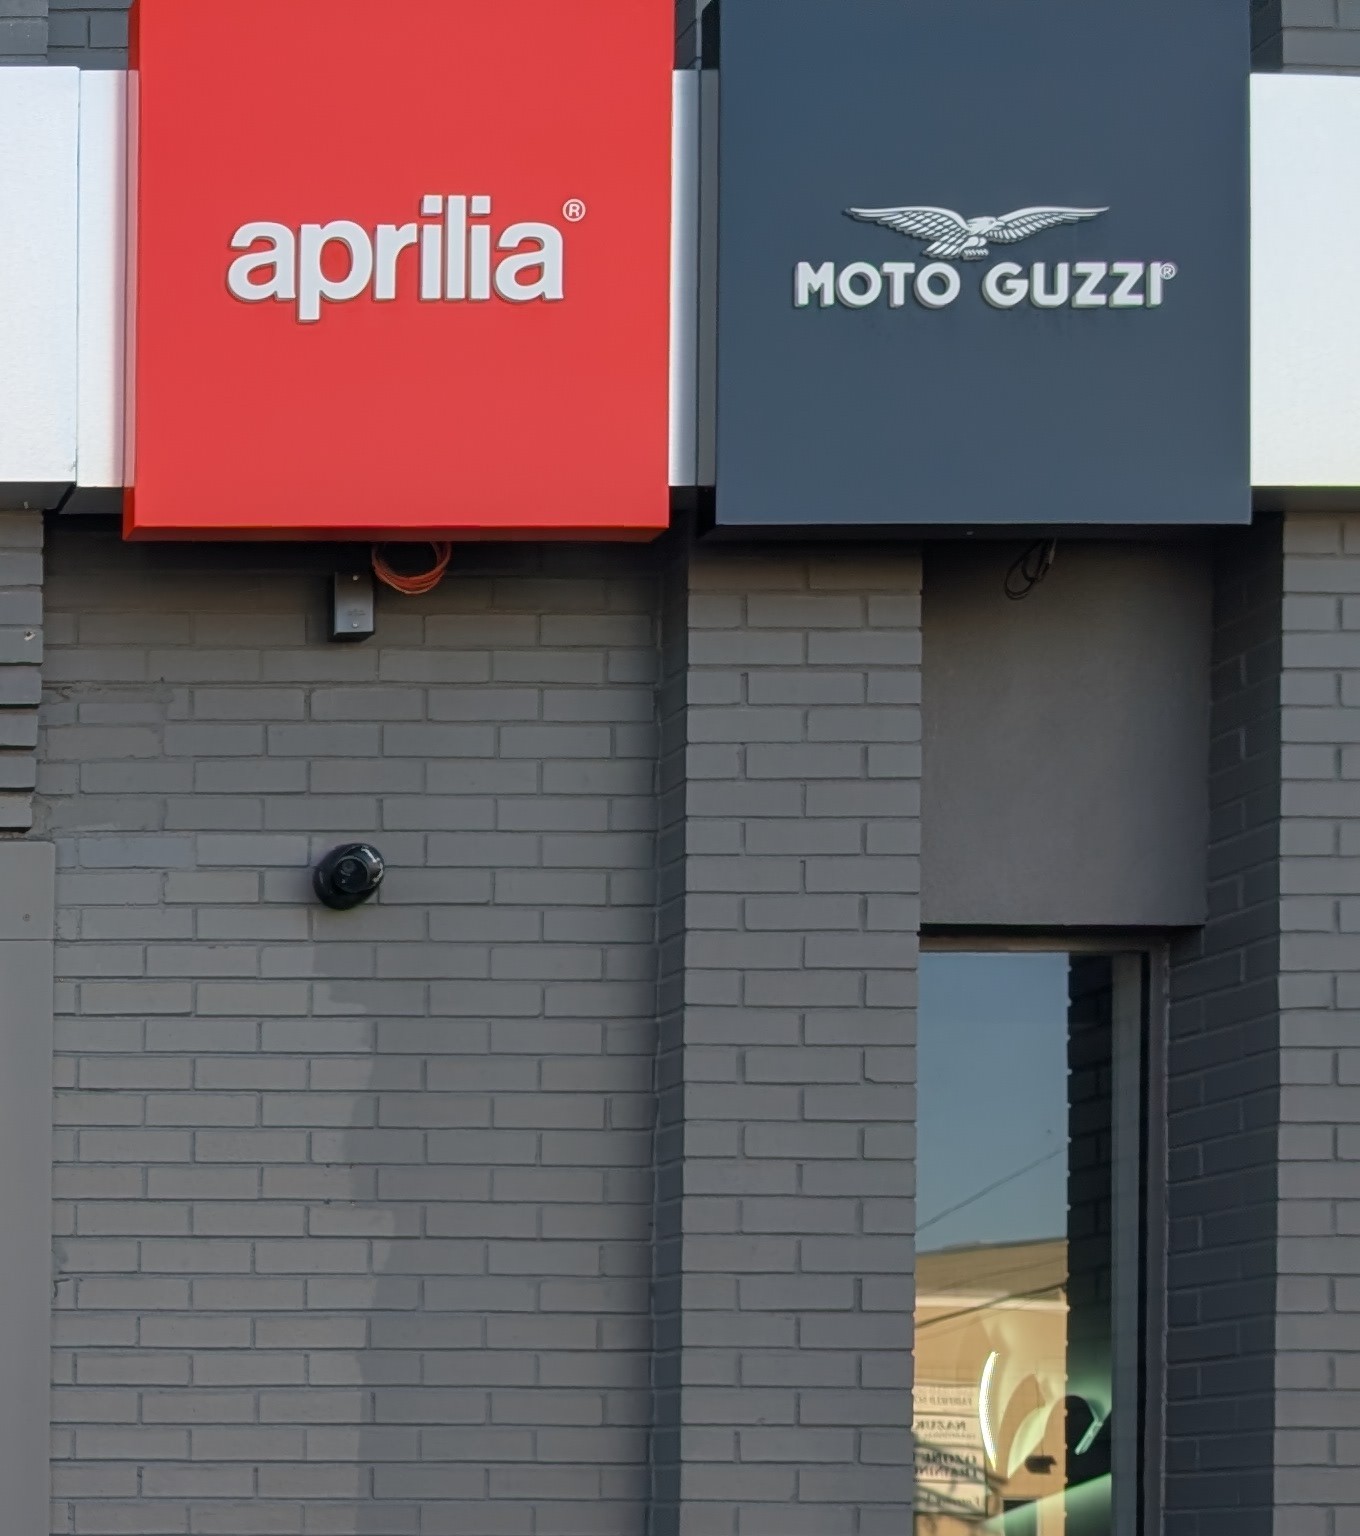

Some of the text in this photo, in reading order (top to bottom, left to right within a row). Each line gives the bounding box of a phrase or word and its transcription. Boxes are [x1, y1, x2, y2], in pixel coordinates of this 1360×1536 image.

[226, 194, 564, 321] aprilia
[795, 261, 1177, 307] MOTO GUZZI
